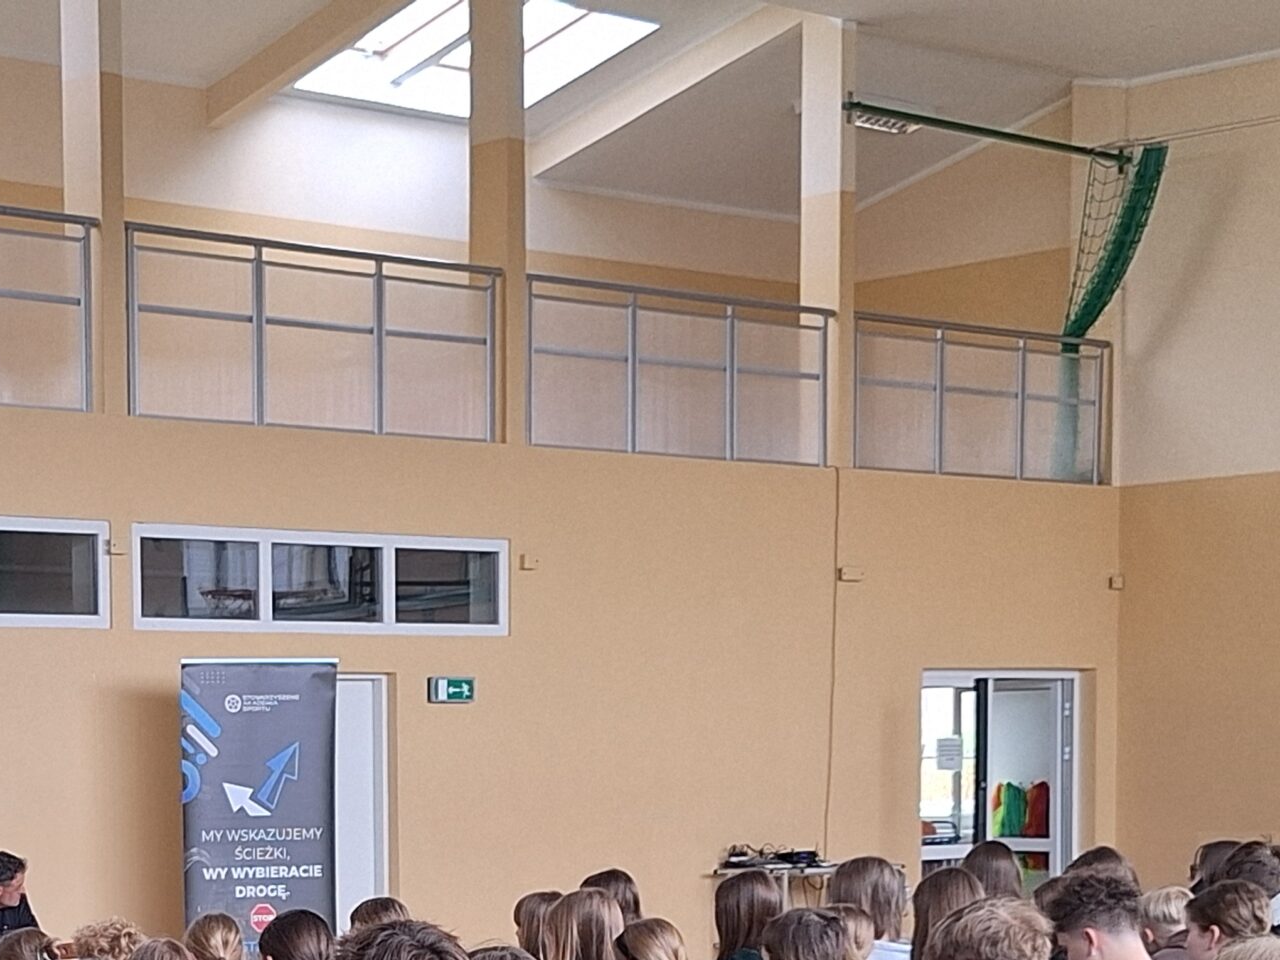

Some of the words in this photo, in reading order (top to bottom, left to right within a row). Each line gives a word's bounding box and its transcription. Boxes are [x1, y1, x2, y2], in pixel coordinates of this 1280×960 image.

[201, 830, 223, 842] MY
[226, 827, 323, 842] WSKAZUJEMY
[234, 845, 291, 861] ŚCIEŻKI,
[202, 867, 228, 880] WY
[231, 864, 323, 879] WYBIERACIE
